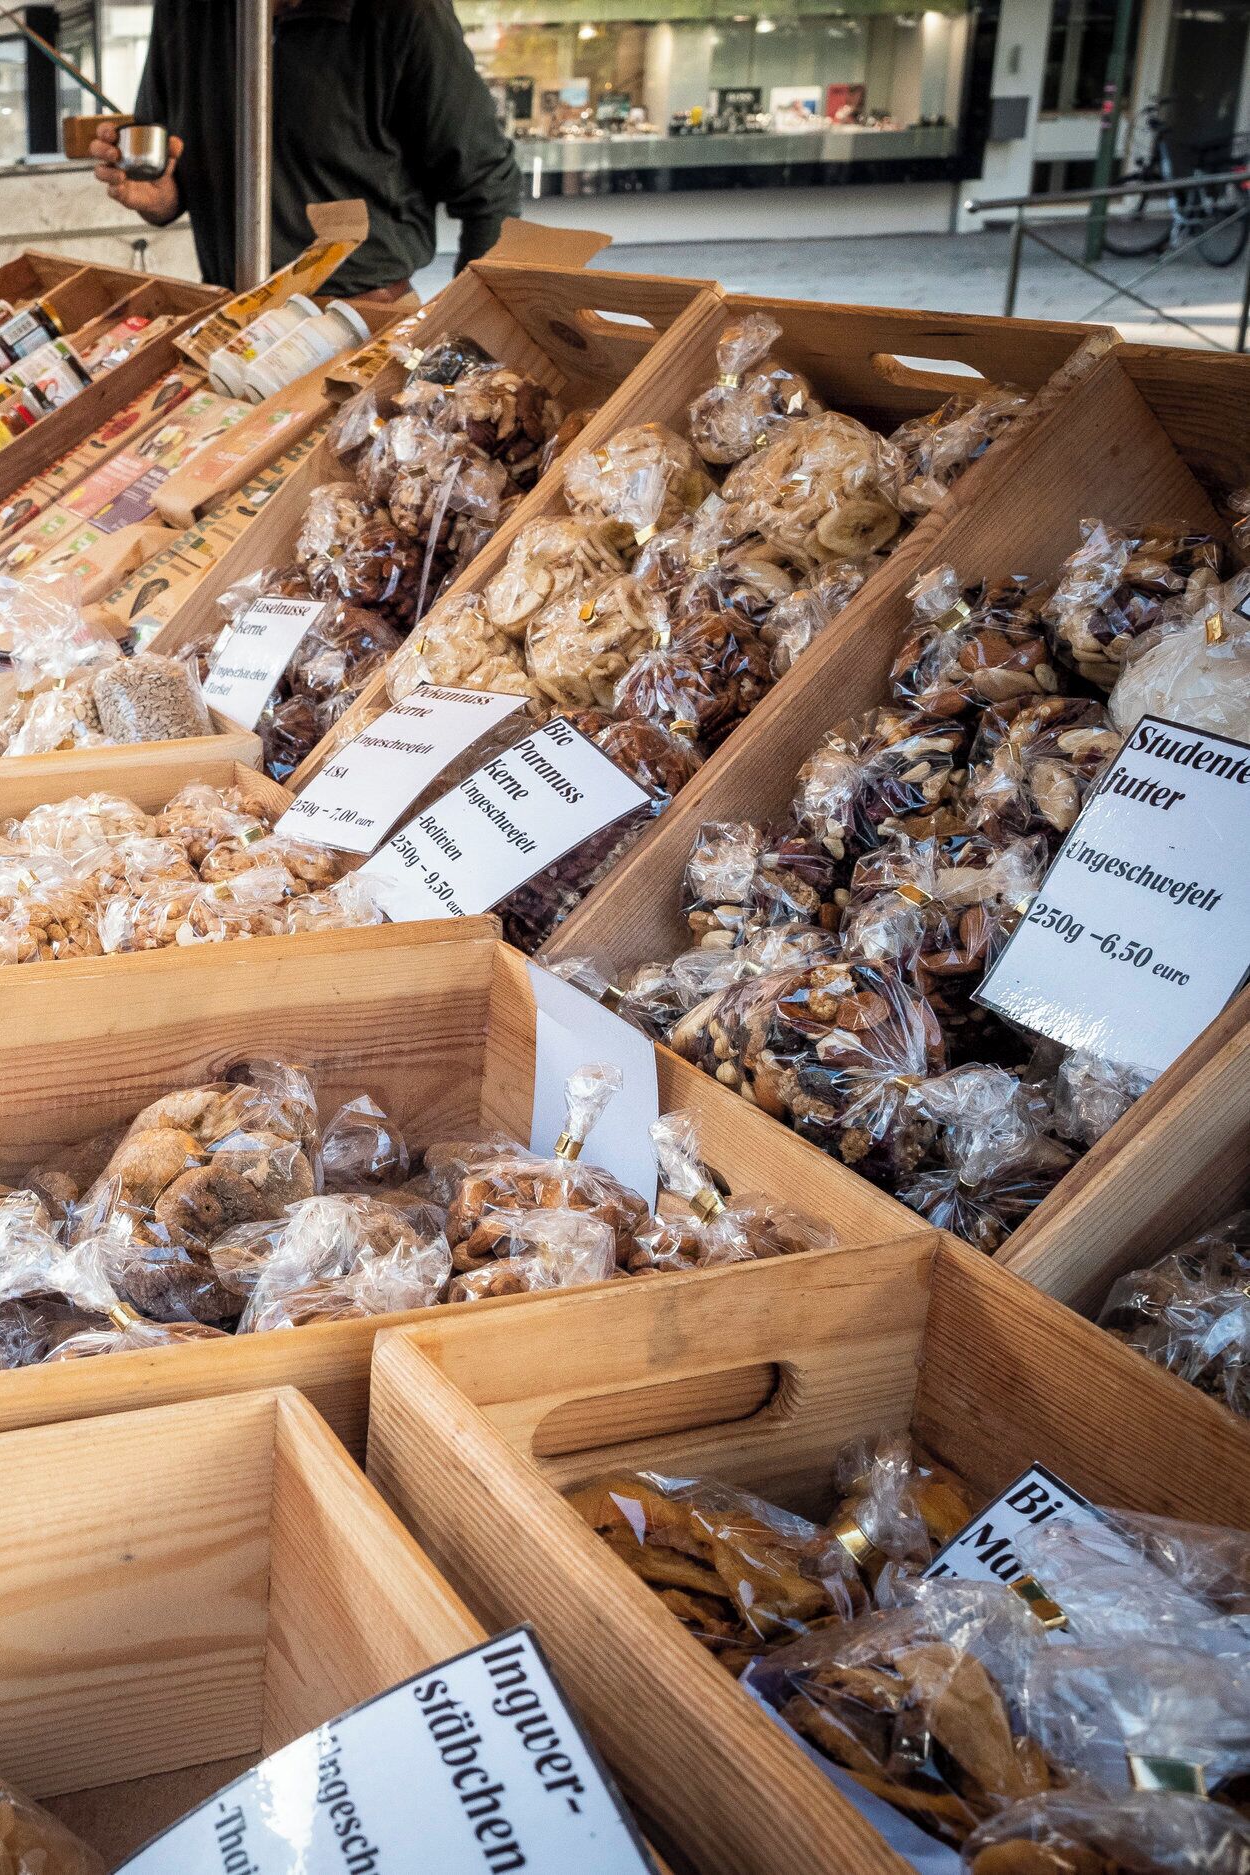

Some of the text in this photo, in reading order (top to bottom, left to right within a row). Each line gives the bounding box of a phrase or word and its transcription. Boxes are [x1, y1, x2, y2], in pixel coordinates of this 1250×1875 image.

[410, 685, 496, 707] Pekannuss
[353, 732, 435, 756] Ungeschwefelt
[542, 720, 575, 747] Bio
[483, 759, 530, 802] Kerne
[512, 738, 585, 805] Paranuss
[1097, 766, 1187, 812] futter
[290, 799, 320, 818] 250g
[329, 807, 359, 823] 7,00
[459, 777, 539, 855] Ungeschwefelt
[418, 815, 464, 862] -Bolivien
[390, 834, 421, 869] 250g
[424, 871, 455, 901] 9,50
[1065, 840, 1225, 913] Ungeschwefelt
[1027, 902, 1087, 944] 250g
[1151, 960, 1191, 987] euro
[1005, 1481, 1064, 1524] Bi
[481, 1643, 586, 1816] Ingwer-
[413, 1678, 528, 1875] stäbchen
